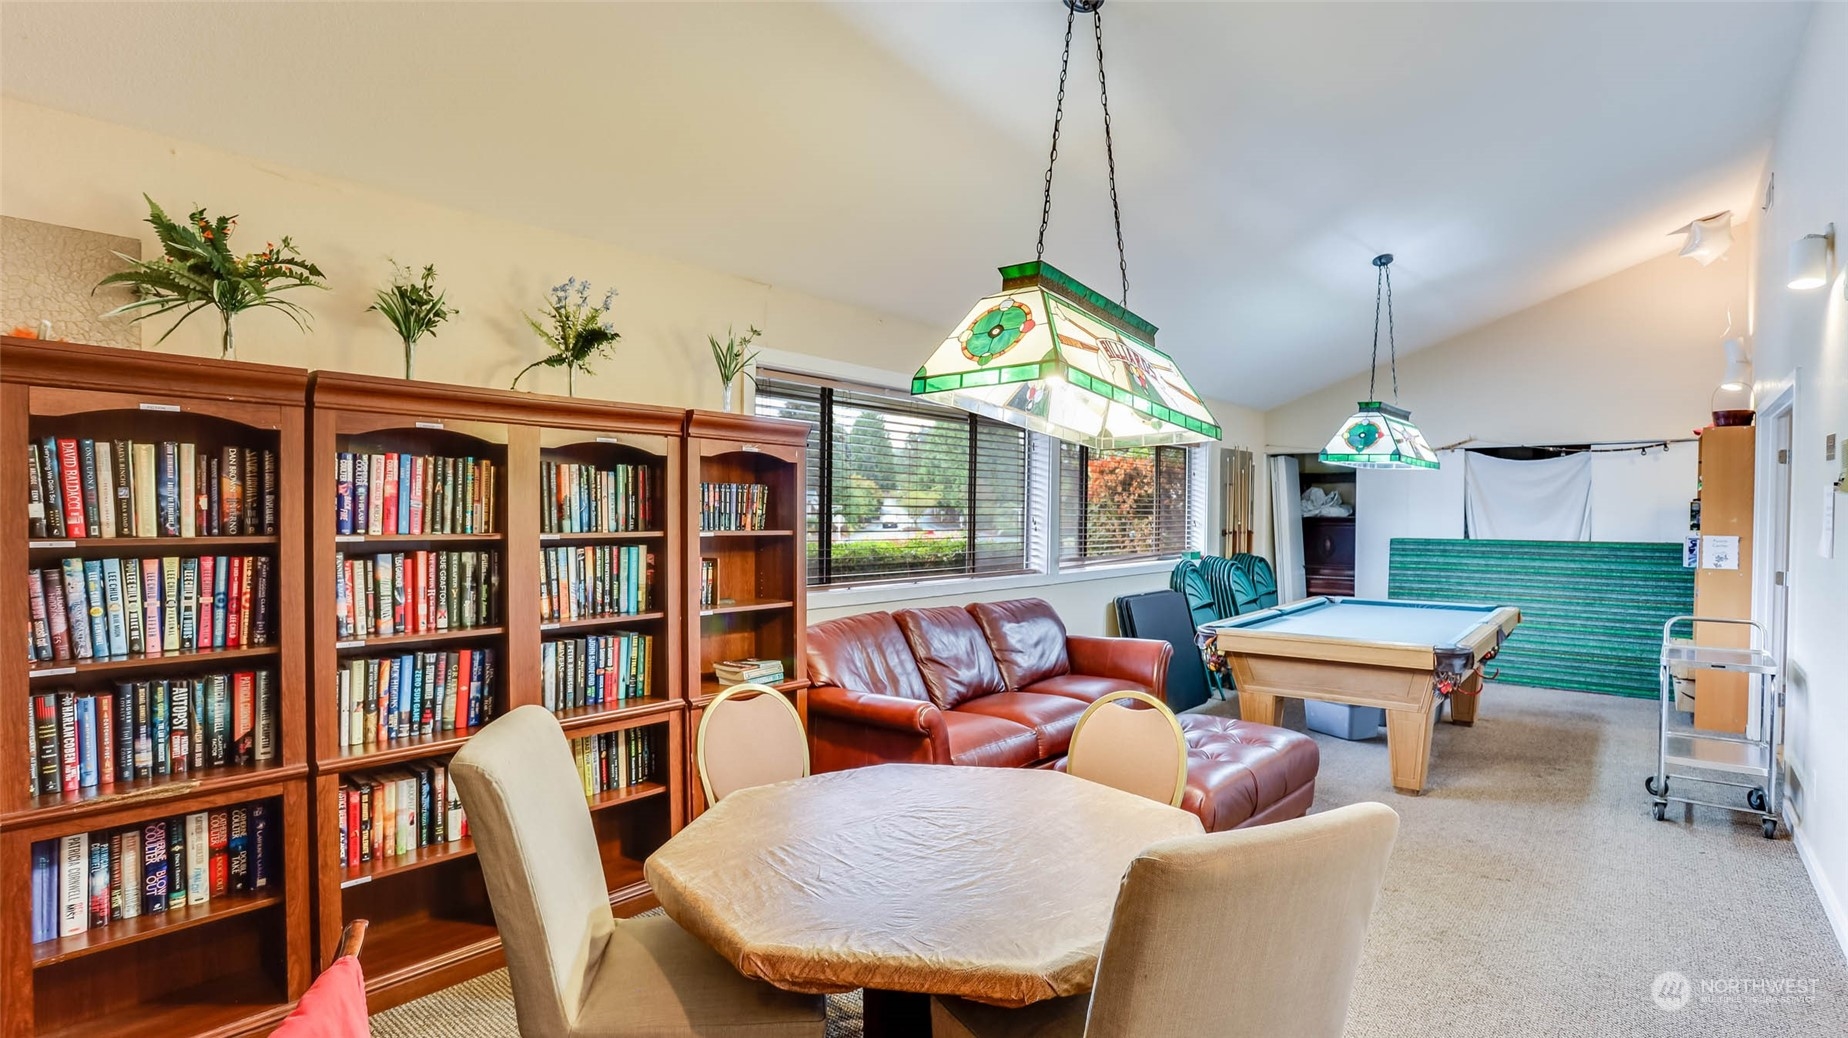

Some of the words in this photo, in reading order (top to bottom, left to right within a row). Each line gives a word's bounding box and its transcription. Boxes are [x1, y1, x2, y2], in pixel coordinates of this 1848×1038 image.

[44, 445, 52, 470] Everything
[62, 442, 76, 467] DAVID
[47, 471, 53, 479] We
[229, 466, 237, 492] BROWN
[64, 470, 81, 510] BALDACCI
[226, 498, 240, 535] INFERNO
[88, 572, 98, 580] LEE
[108, 572, 116, 582] LEE
[126, 572, 136, 583] LEE
[147, 573, 155, 582] LEE
[167, 570, 175, 580] LEE
[184, 570, 193, 579] LEE
[109, 583, 118, 601] CHILD
[128, 585, 137, 601] CHILD
[148, 583, 156, 599] CHILD
[167, 582, 175, 597] CHILD
[184, 580, 193, 596] CHILD
[130, 613, 139, 629] MAKE
[131, 630, 140, 640] ME
[214, 676, 224, 702] PATRICIA
[390, 679, 399, 708] HIGGINS
[172, 688, 188, 730] AUTOPSY
[62, 706, 75, 738] HARLAN
[64, 738, 76, 763] COBEN
[156, 822, 167, 862] CATHERINE
[211, 815, 219, 845] COULTER
[68, 837, 80, 867] PATRICIA
[91, 843, 100, 873] CORNWELL
[145, 826, 155, 865] COULTER
[68, 868, 80, 902] CORNWELL
[146, 876, 155, 895] OUT
[156, 870, 167, 895] BLOW
[66, 904, 75, 920] MIST
